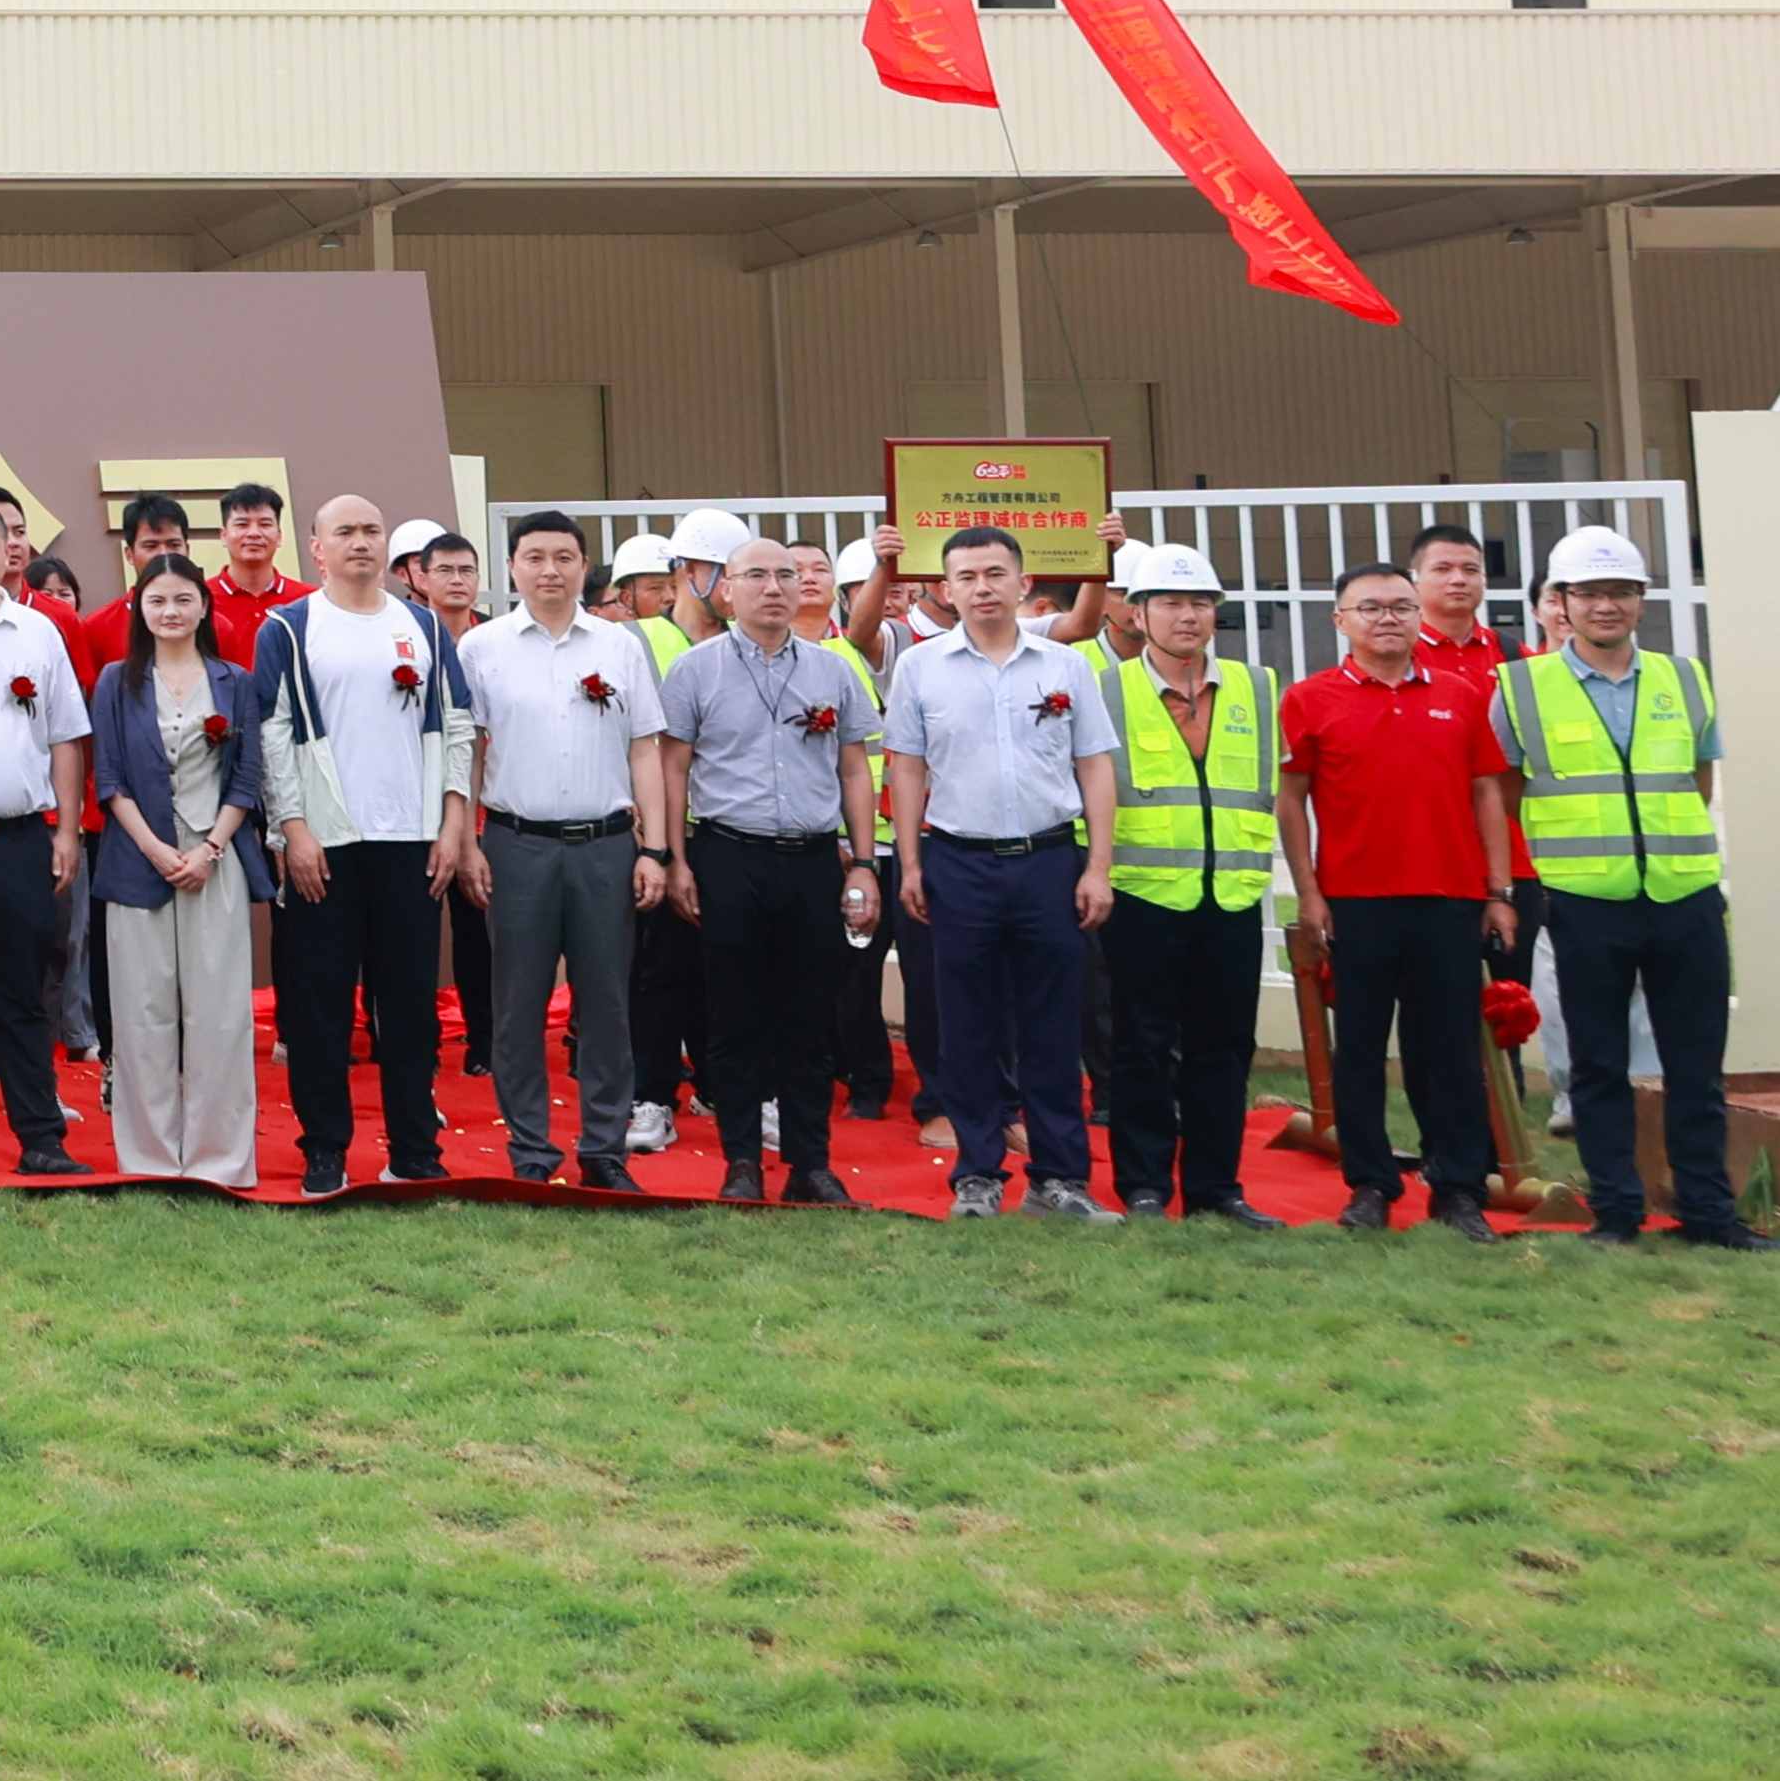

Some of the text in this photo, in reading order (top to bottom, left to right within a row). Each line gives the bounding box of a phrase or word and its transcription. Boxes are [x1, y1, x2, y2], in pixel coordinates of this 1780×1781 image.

[941, 491, 1061, 504] 方舟工程管理有限公司
[916, 510, 1089, 529] 公正监理诚信合作商
